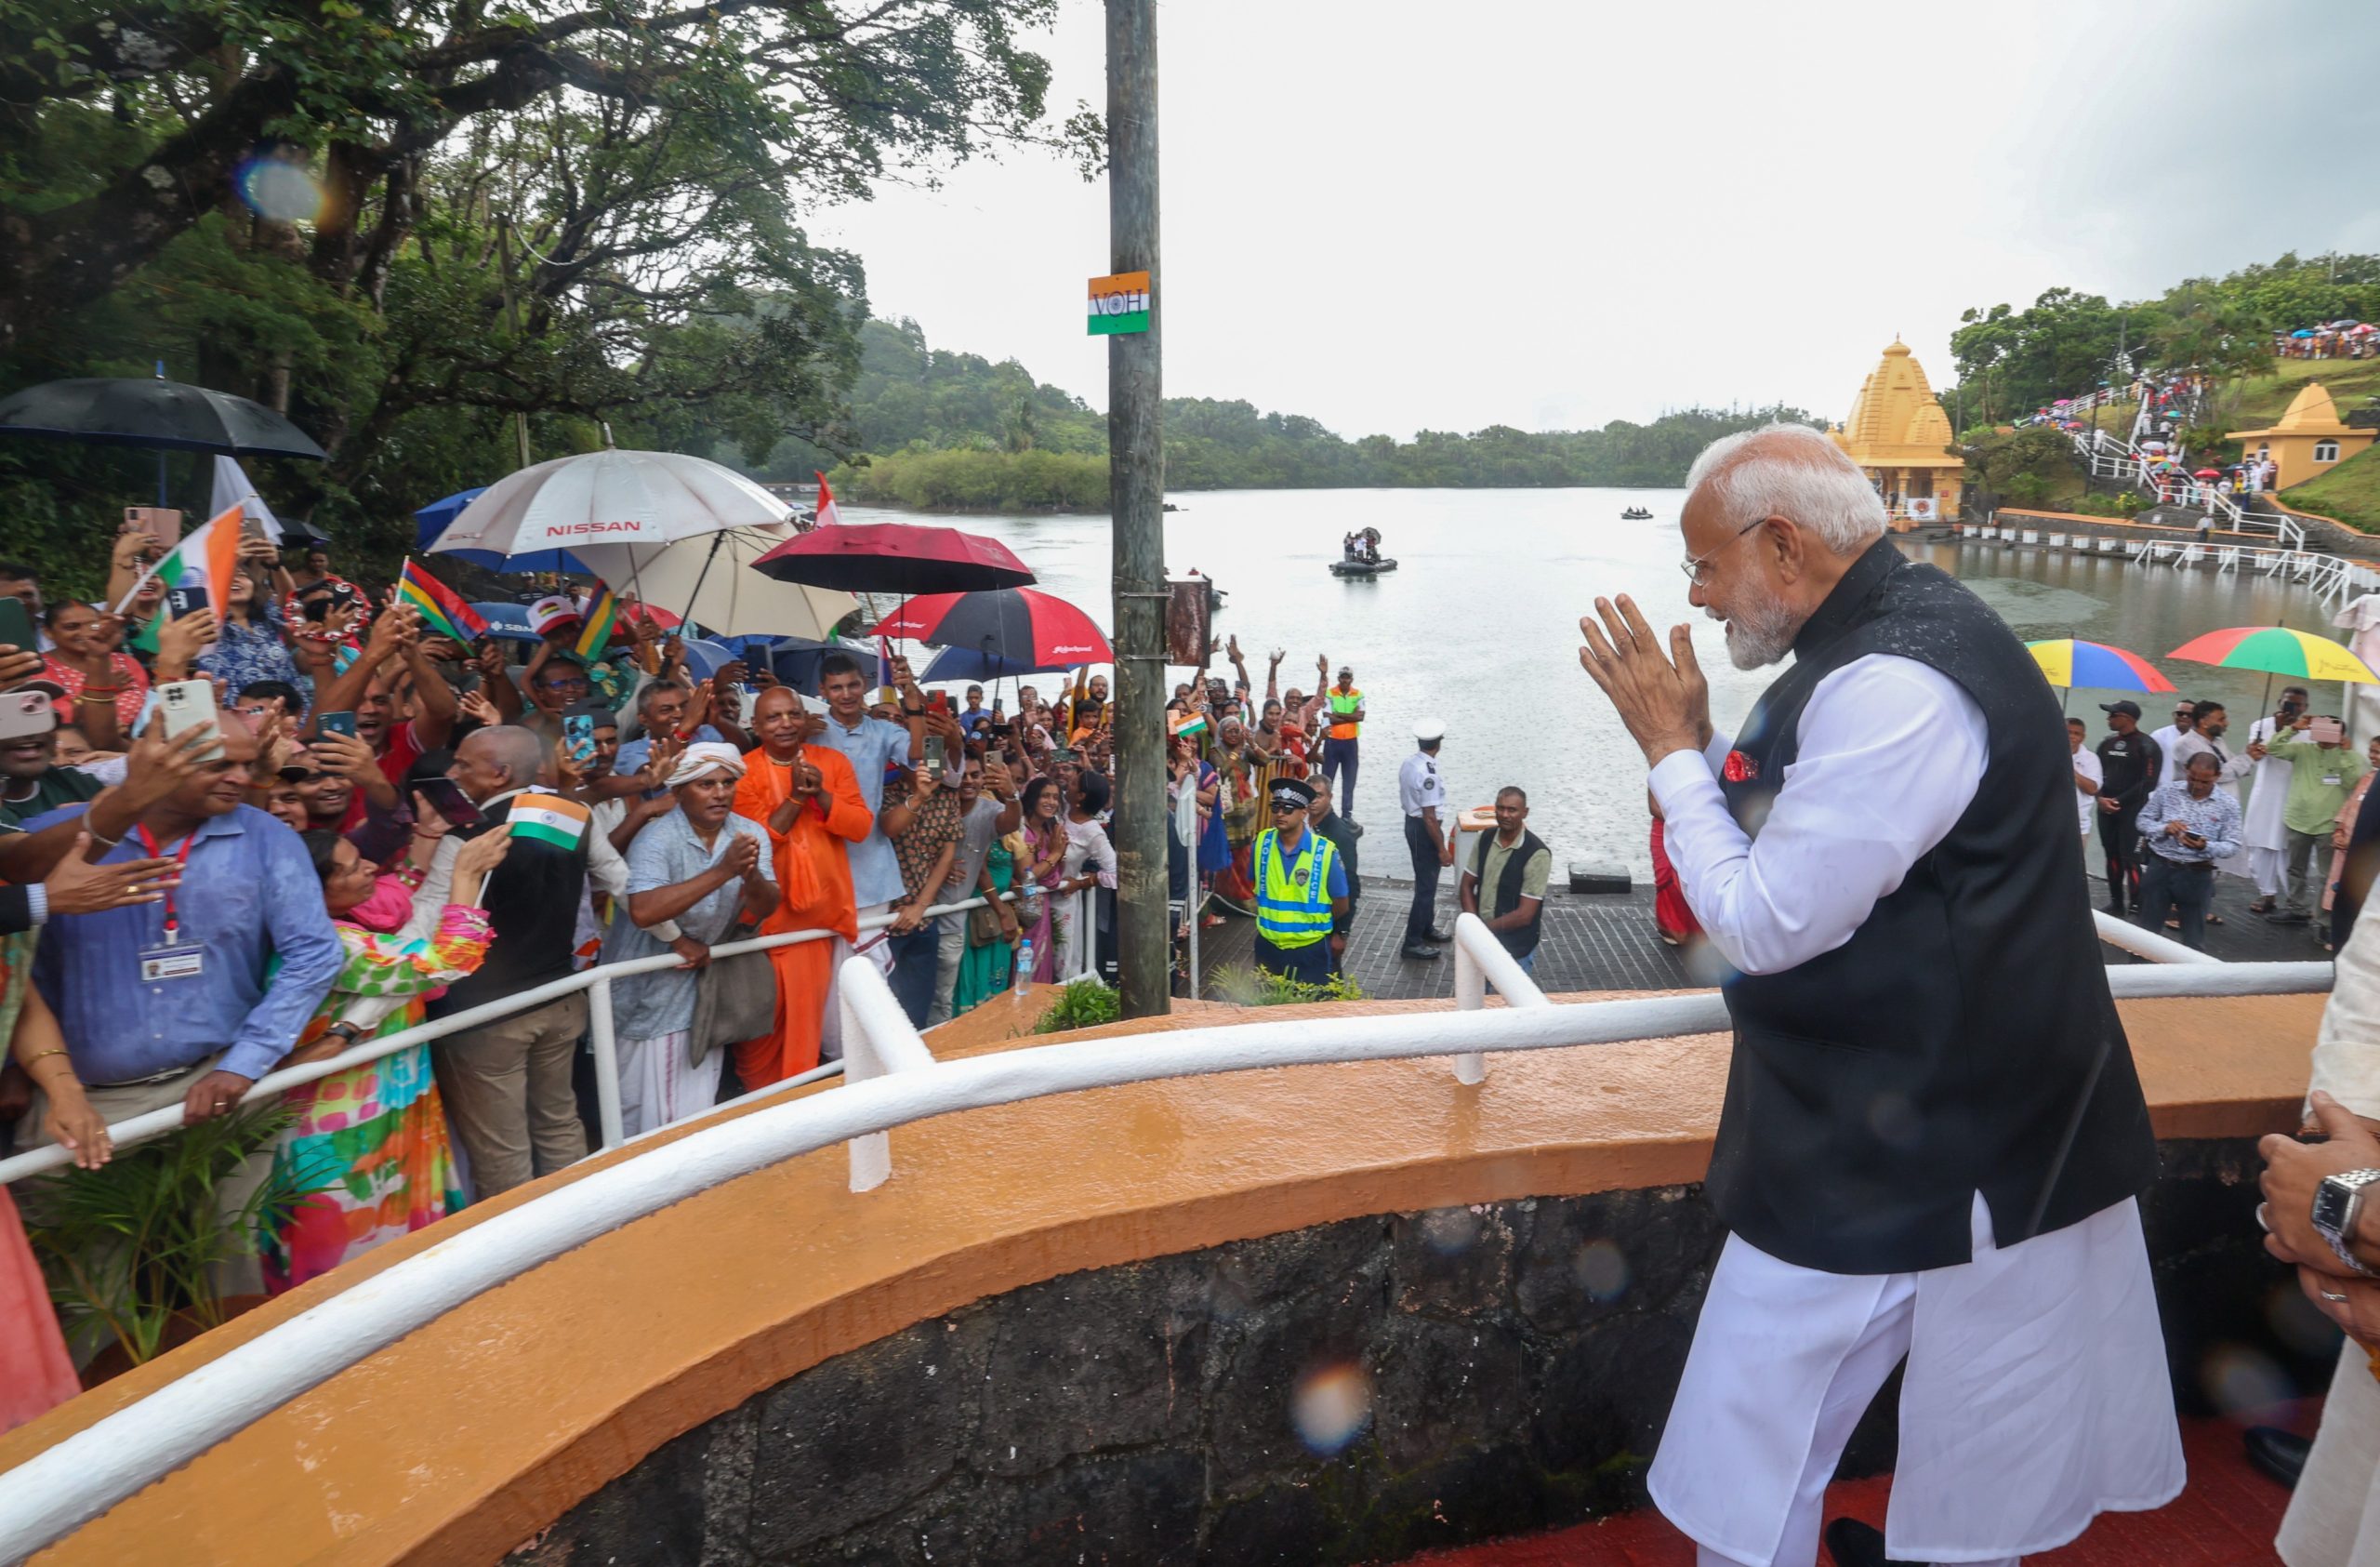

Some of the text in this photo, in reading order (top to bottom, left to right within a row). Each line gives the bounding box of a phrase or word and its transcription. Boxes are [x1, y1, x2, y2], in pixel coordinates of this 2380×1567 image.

[1093, 289, 1144, 317] VOH
[547, 521, 641, 537] NISSAN
[1261, 838, 1271, 892] POLICE
[1310, 845, 1325, 898] POLICE
